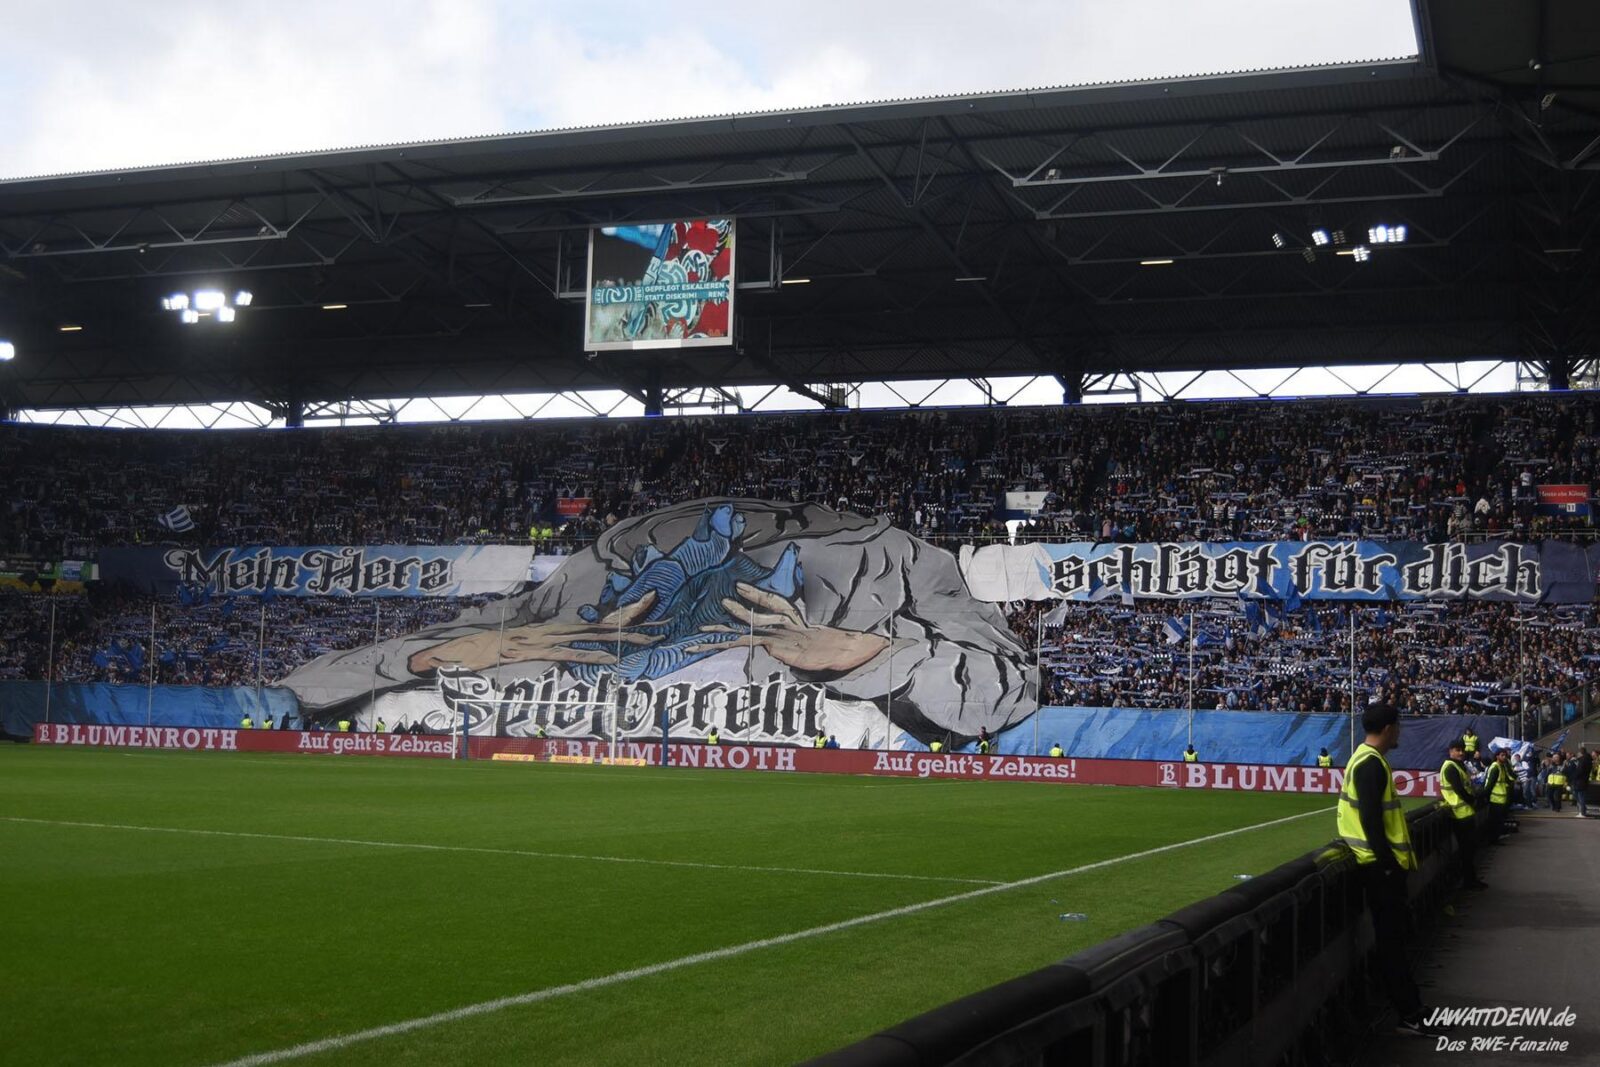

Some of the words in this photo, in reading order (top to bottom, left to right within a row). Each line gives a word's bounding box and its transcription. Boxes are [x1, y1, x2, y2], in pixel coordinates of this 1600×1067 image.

[645, 285, 680, 293] GEPFLEGT
[682, 283, 725, 291] ESKALIEREN
[163, 546, 300, 594] Mein
[301, 547, 453, 594] Herz
[1050, 544, 1282, 597] schlägt
[1289, 542, 1397, 597] für
[1402, 542, 1542, 597] dich
[422, 665, 826, 740] Spielverein
[55, 724, 238, 750] BLUMENROTH
[298, 731, 331, 750] Auf
[390, 734, 459, 754] Zebras!
[567, 740, 796, 771] BLUMENROTH
[873, 752, 915, 772] Auf
[990, 756, 1077, 779] Zebras!
